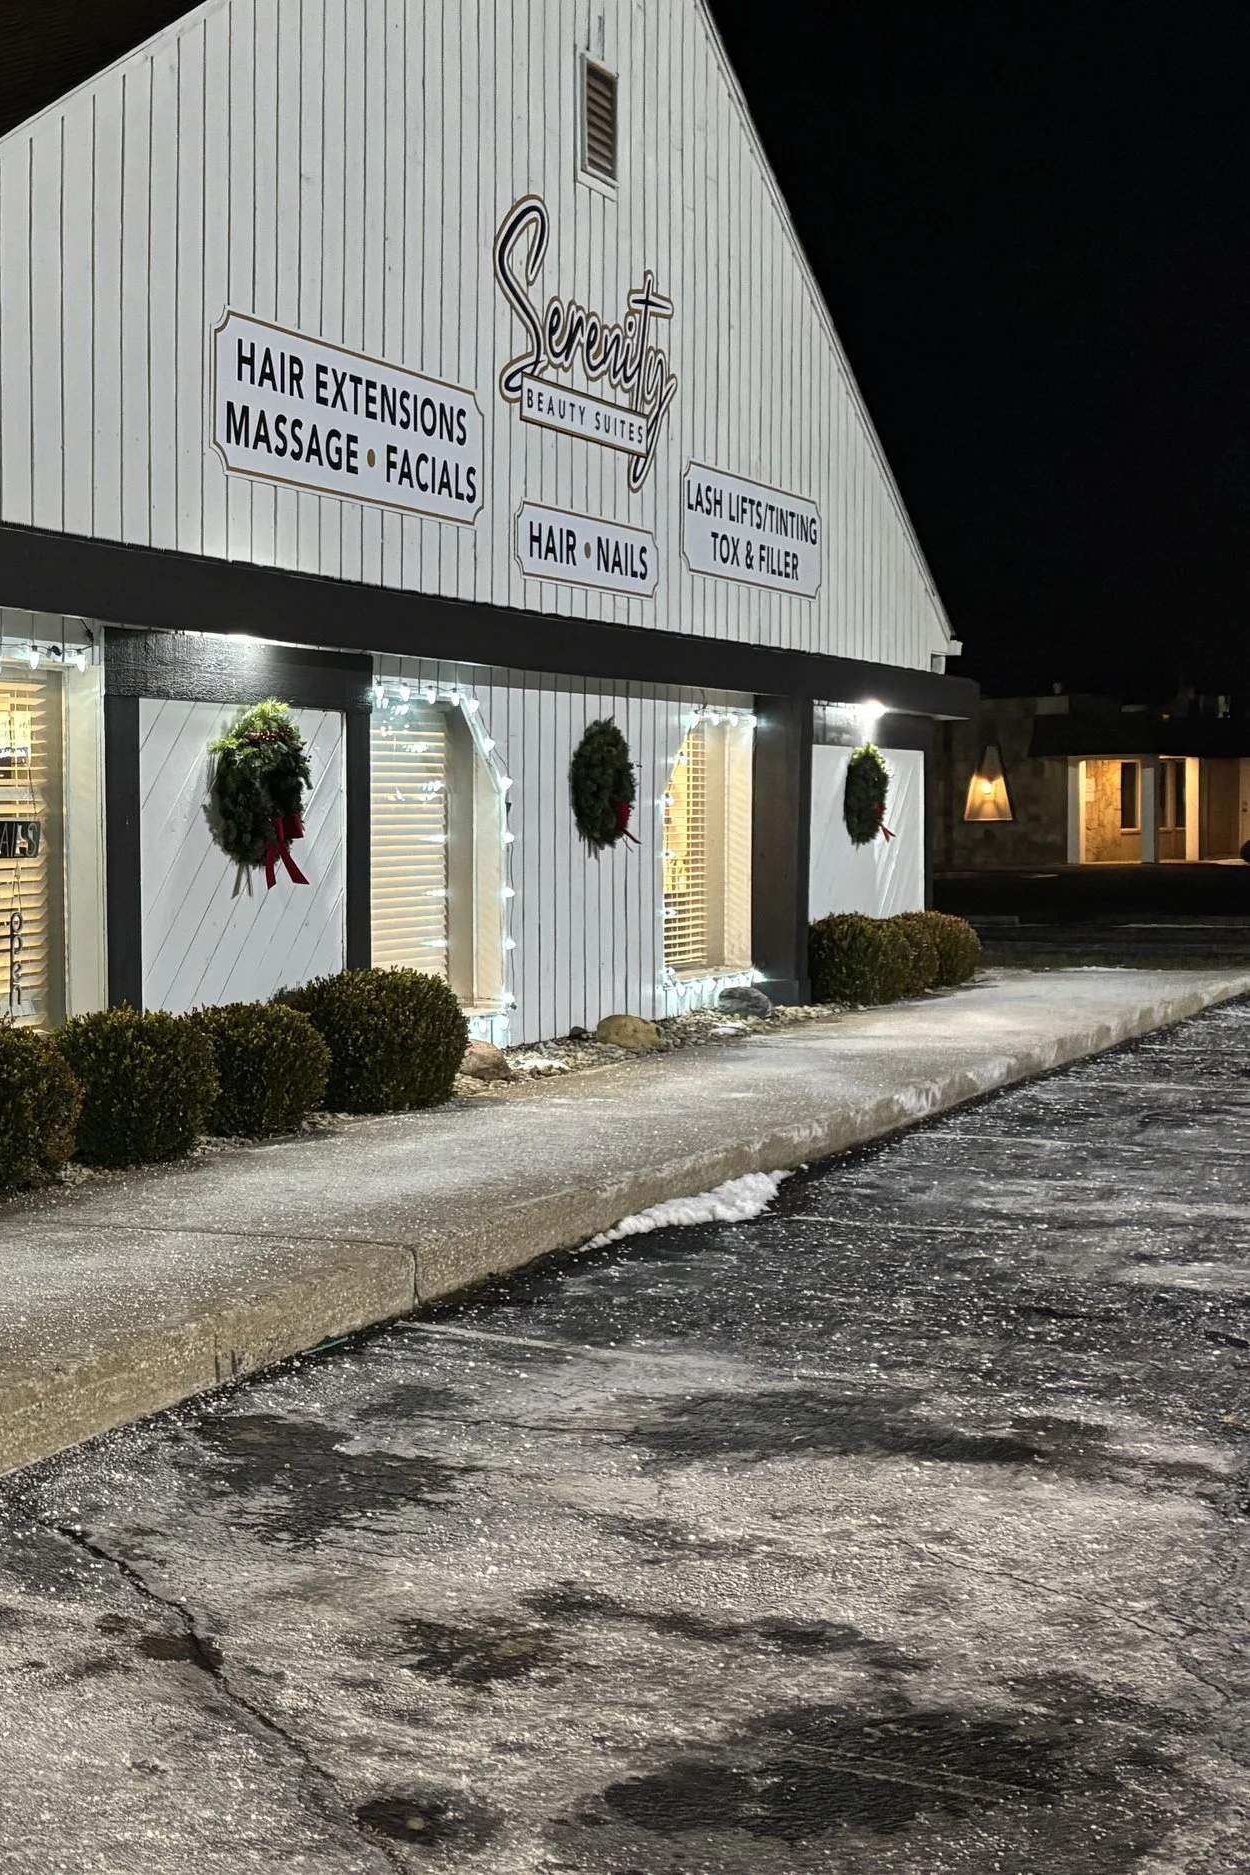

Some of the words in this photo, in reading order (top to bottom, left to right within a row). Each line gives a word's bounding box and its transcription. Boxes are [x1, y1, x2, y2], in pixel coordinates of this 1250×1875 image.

[496, 202, 677, 486] Serenity
[237, 337, 304, 399] HAIR
[315, 362, 467, 446] EXTENSIONS
[526, 388, 586, 425] BEAUTY
[595, 411, 644, 444] SUITES
[226, 400, 359, 475] MASSAGE
[385, 443, 477, 504] FACIALS
[687, 479, 723, 519] LASH
[728, 494, 818, 546] LIFTS/TINTING
[529, 520, 577, 566] HAIR
[596, 535, 648, 580] NAILS
[710, 531, 740, 569] TOX
[745, 539, 754, 569] &
[758, 543, 799, 581] FILLER
